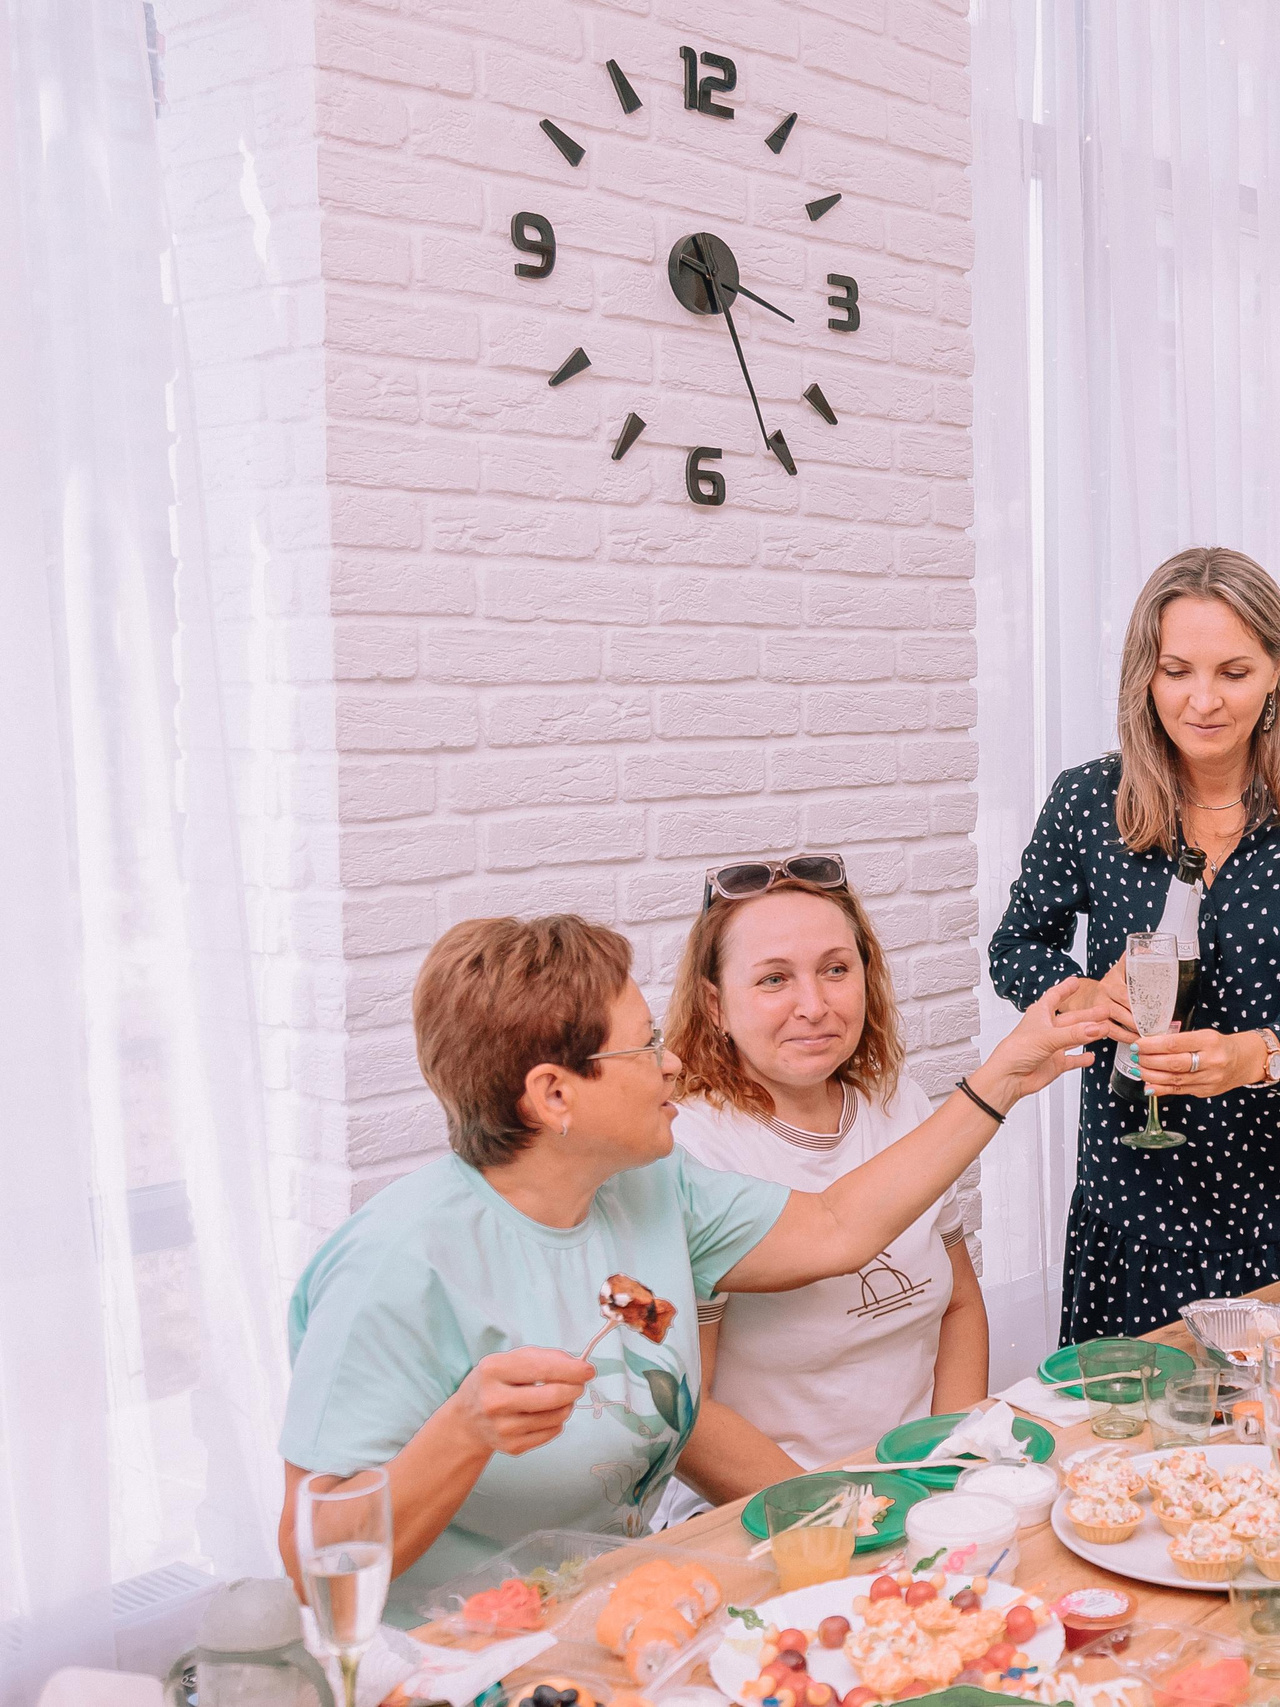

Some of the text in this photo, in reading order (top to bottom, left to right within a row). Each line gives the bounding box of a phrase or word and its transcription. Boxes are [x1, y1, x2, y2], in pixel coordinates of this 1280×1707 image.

[679, 46, 737, 119] 12
[511, 212, 556, 279] 9
[827, 273, 860, 332] 3
[686, 446, 726, 506] 6
